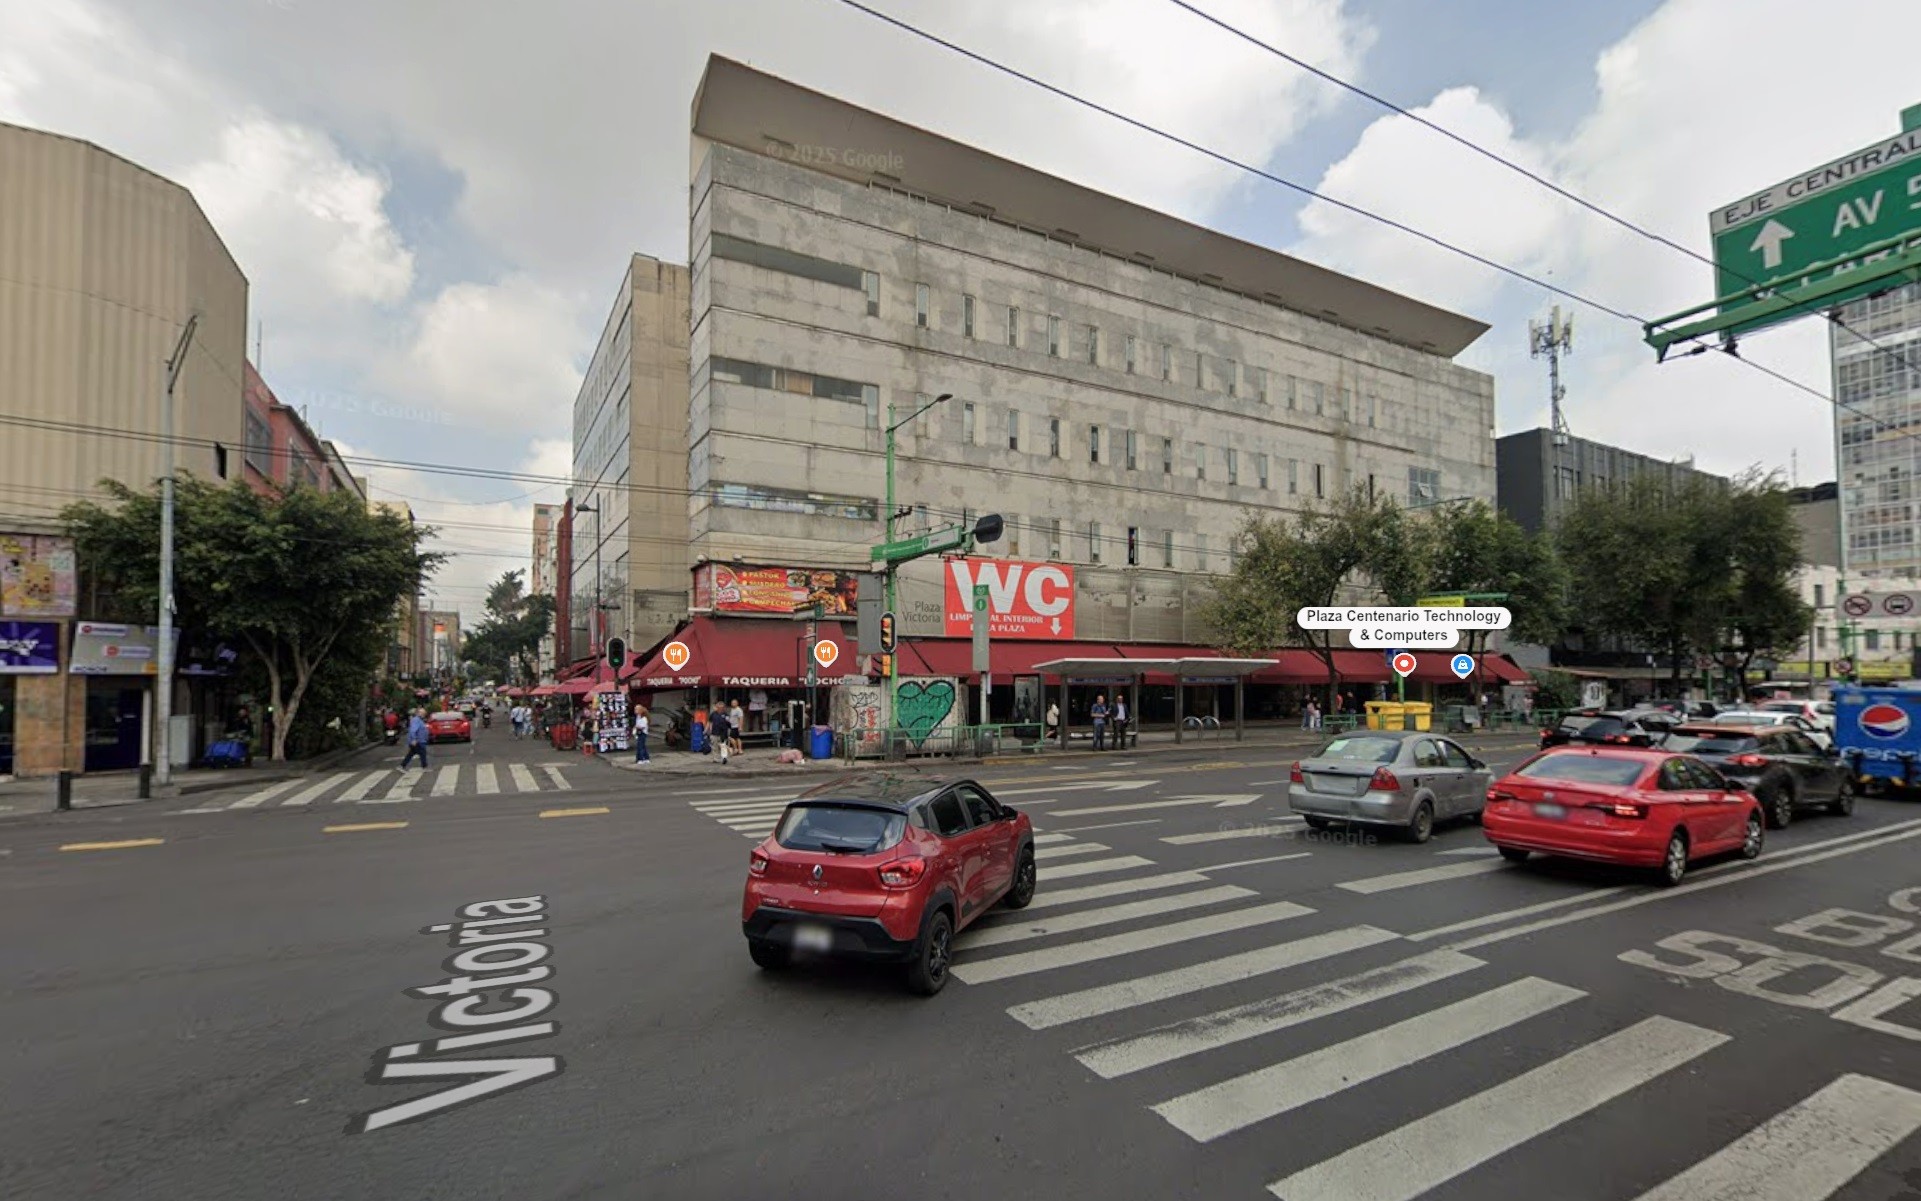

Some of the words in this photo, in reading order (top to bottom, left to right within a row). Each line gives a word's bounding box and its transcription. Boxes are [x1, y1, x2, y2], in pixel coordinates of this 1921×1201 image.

[1725, 191, 1774, 224] EJE
[1786, 134, 1921, 197] CENTRAL
[1832, 189, 1886, 238] AV
[749, 571, 780, 579] PASTOR
[950, 560, 1070, 616] WC
[914, 601, 941, 612] Plaza
[902, 611, 941, 623] Victoria
[950, 612, 973, 621] LIMP
[1003, 615, 1044, 624] INTERIOR
[998, 624, 1025, 632] PLAZA
[721, 677, 790, 686] TAQUERIA
